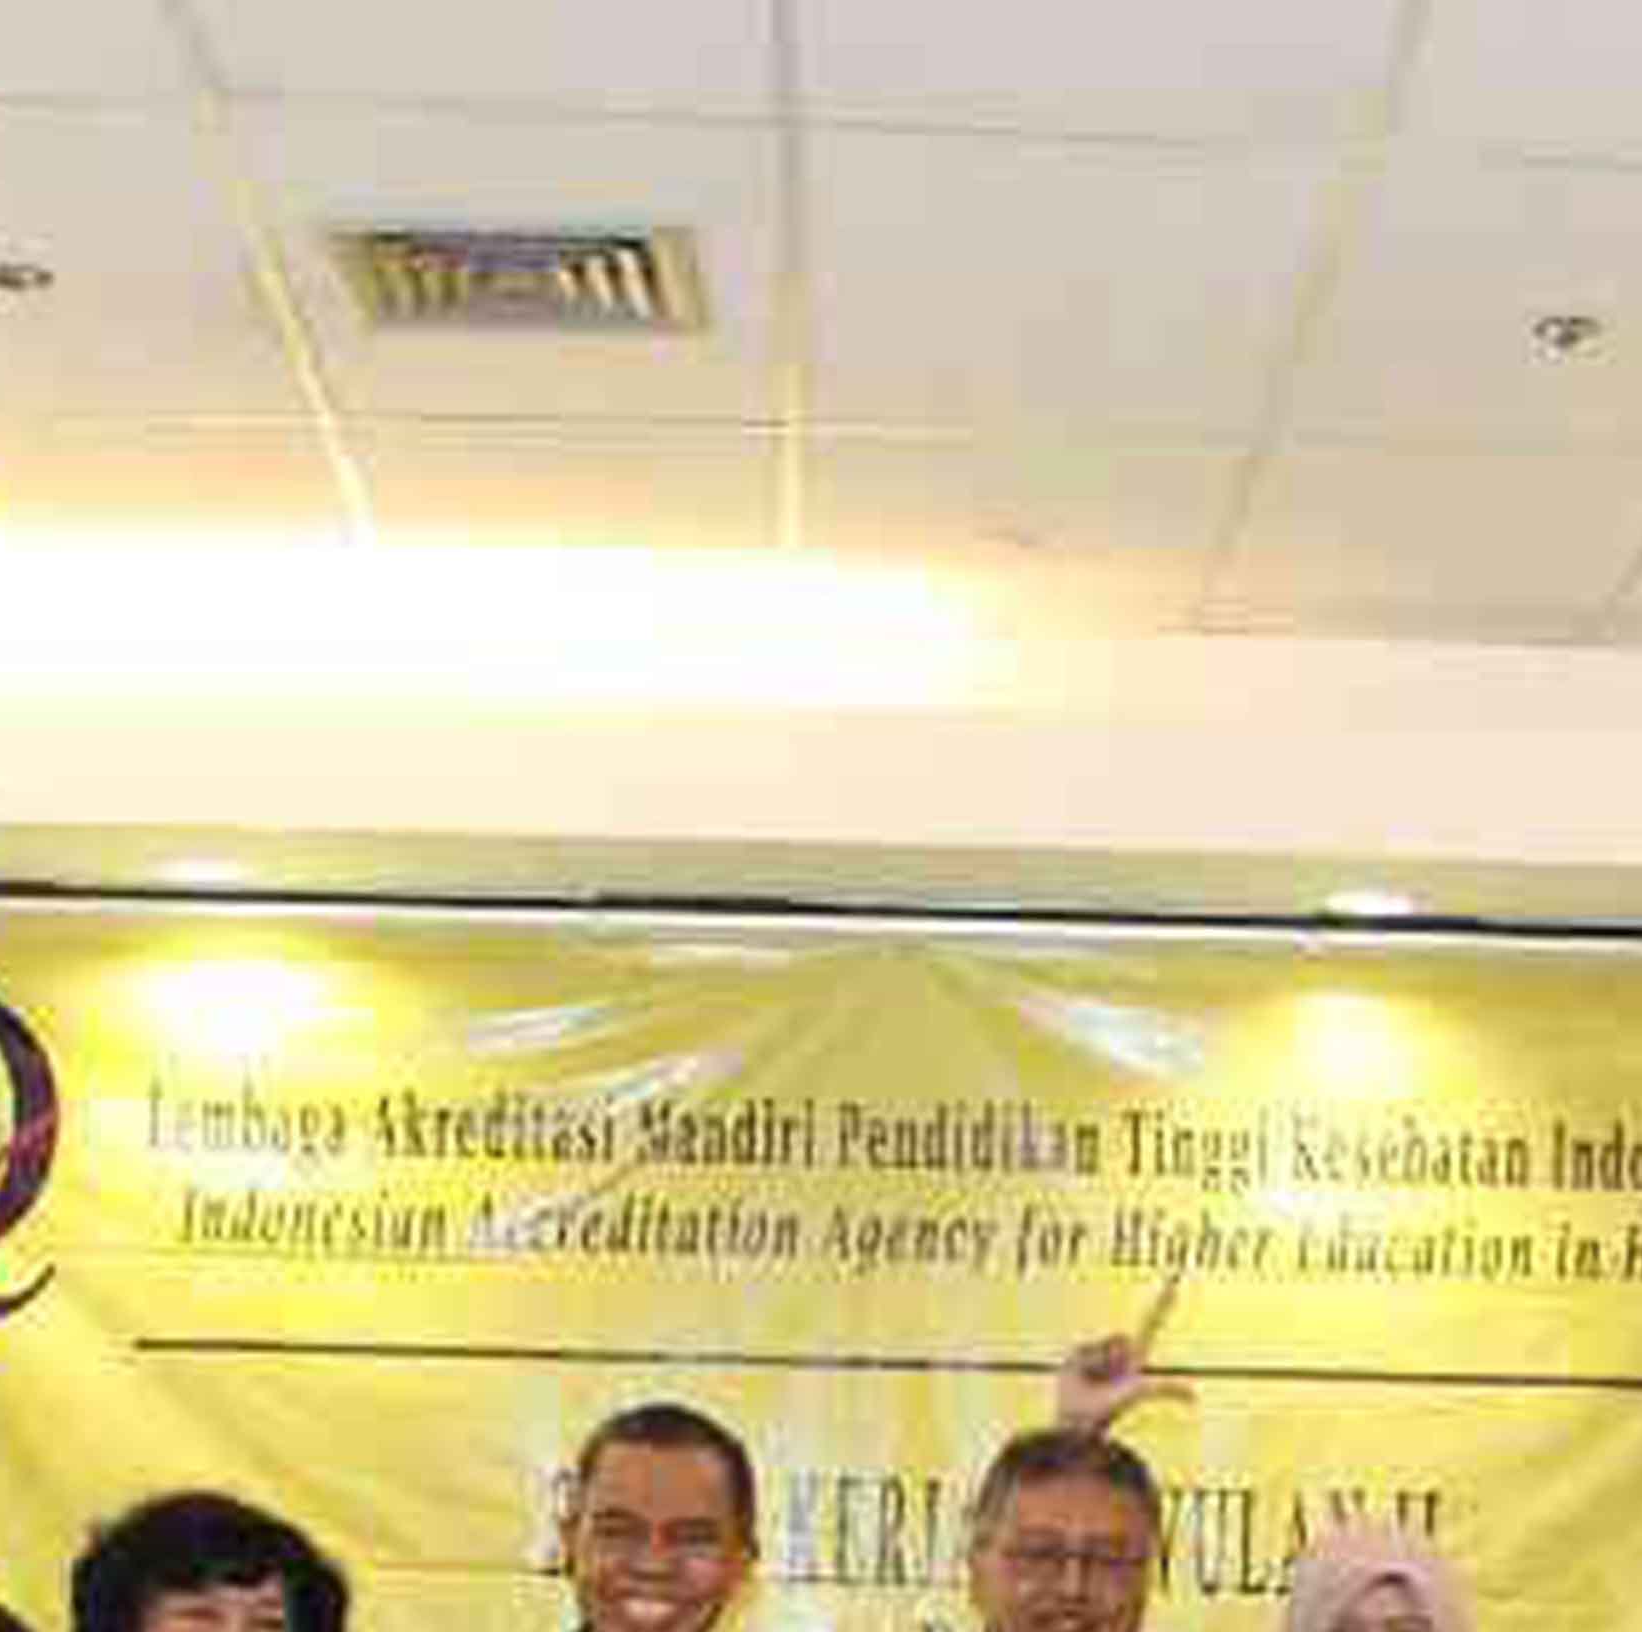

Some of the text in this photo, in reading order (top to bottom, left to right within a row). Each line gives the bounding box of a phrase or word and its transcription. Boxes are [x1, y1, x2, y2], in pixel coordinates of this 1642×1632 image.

[148, 1075, 347, 1178] Lembaga
[375, 1086, 614, 1164] Akreditasi
[635, 1096, 817, 1172] Mandiri
[837, 1100, 1100, 1177] Pendidikan
[1121, 1106, 1267, 1197] Tinggi
[1290, 1108, 1530, 1190] Kesehatan
[177, 1185, 449, 1250] Indonesian
[465, 1190, 798, 1262] Accreditation
[822, 1205, 996, 1279] Agency
[1012, 1206, 1089, 1279] for
[1109, 1206, 1274, 1280] Higher
[1292, 1212, 1536, 1282] Education
[1556, 1220, 1605, 1282] in
